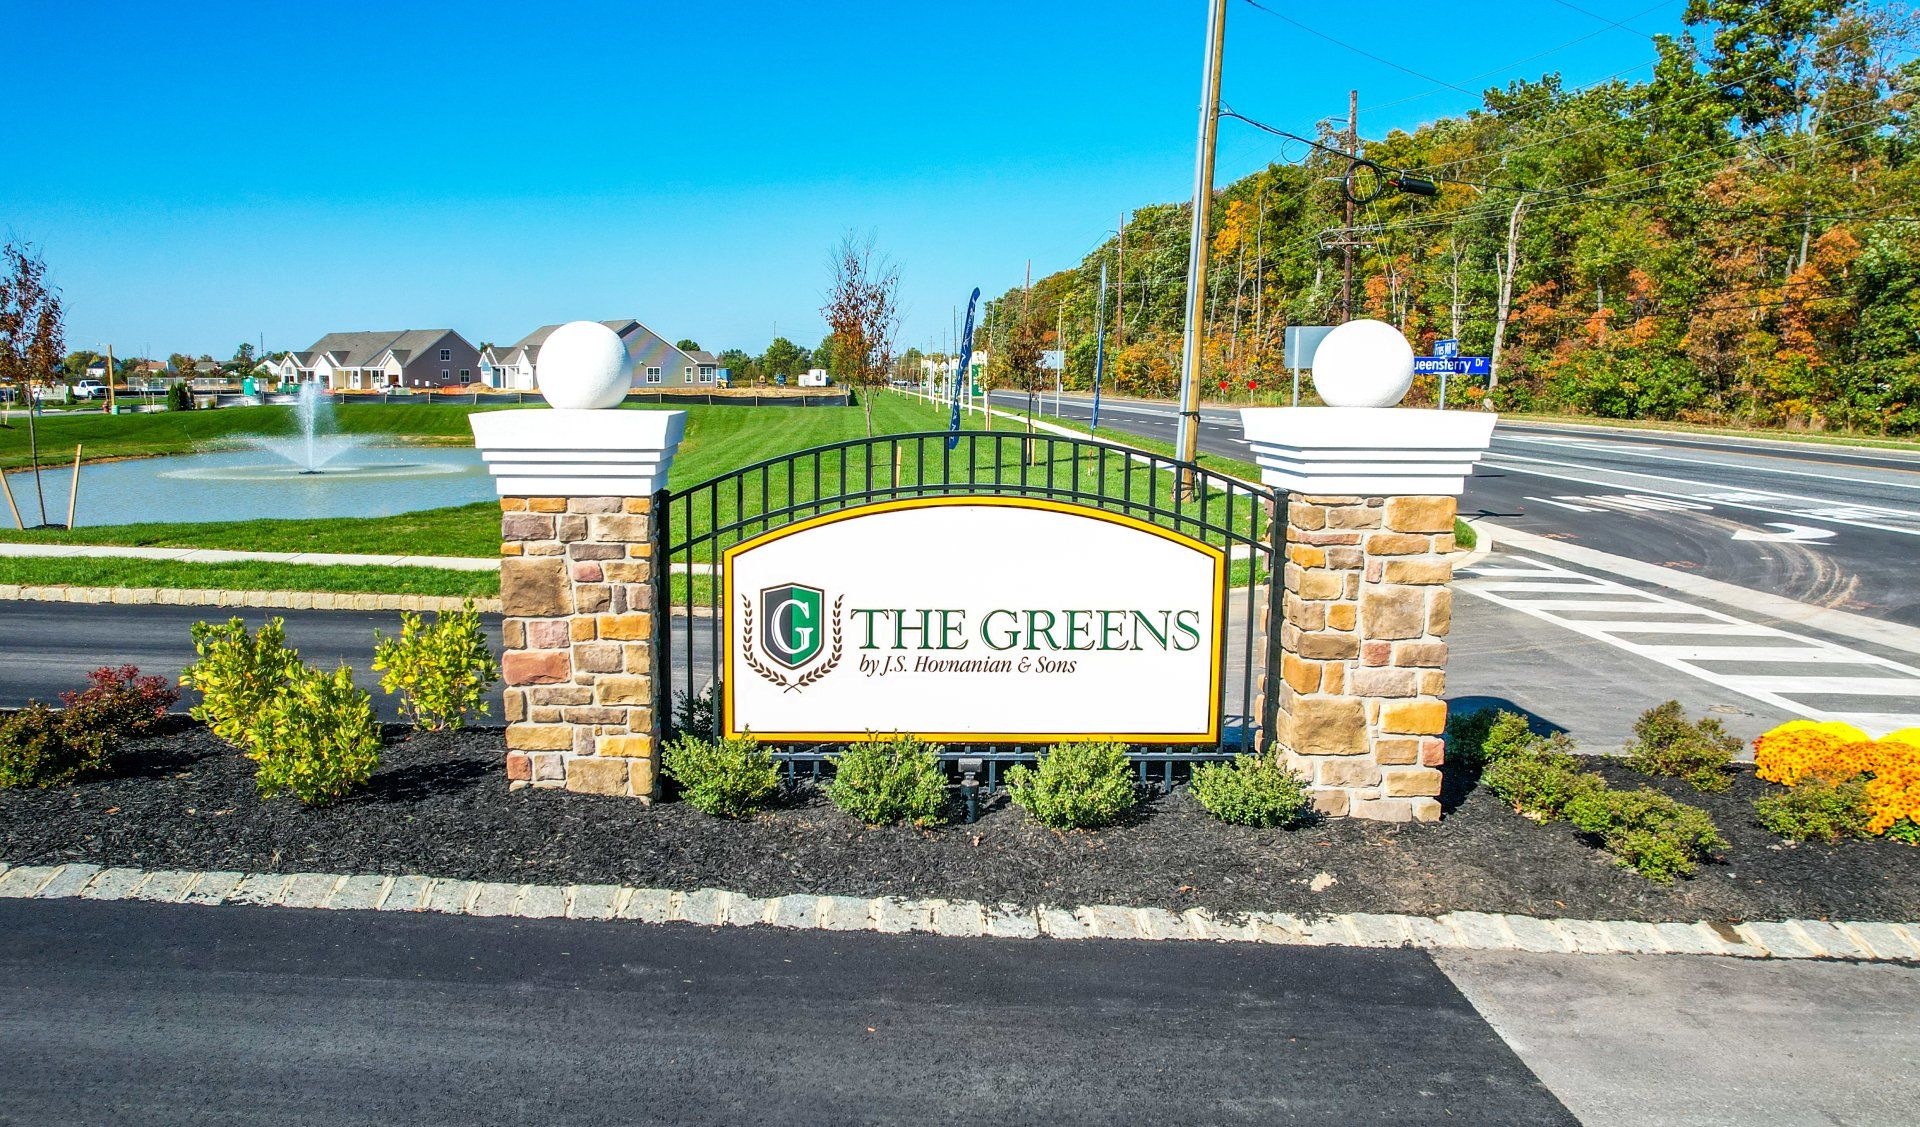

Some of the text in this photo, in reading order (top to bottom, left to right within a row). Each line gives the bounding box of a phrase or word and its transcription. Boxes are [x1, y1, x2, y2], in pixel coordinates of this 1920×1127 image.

[1414, 358, 1484, 373] ueensferry Dr
[771, 599, 814, 654] G
[851, 609, 1200, 651] THE GREENS
[859, 655, 1078, 677] by J.S. Hovnanian & Sons
